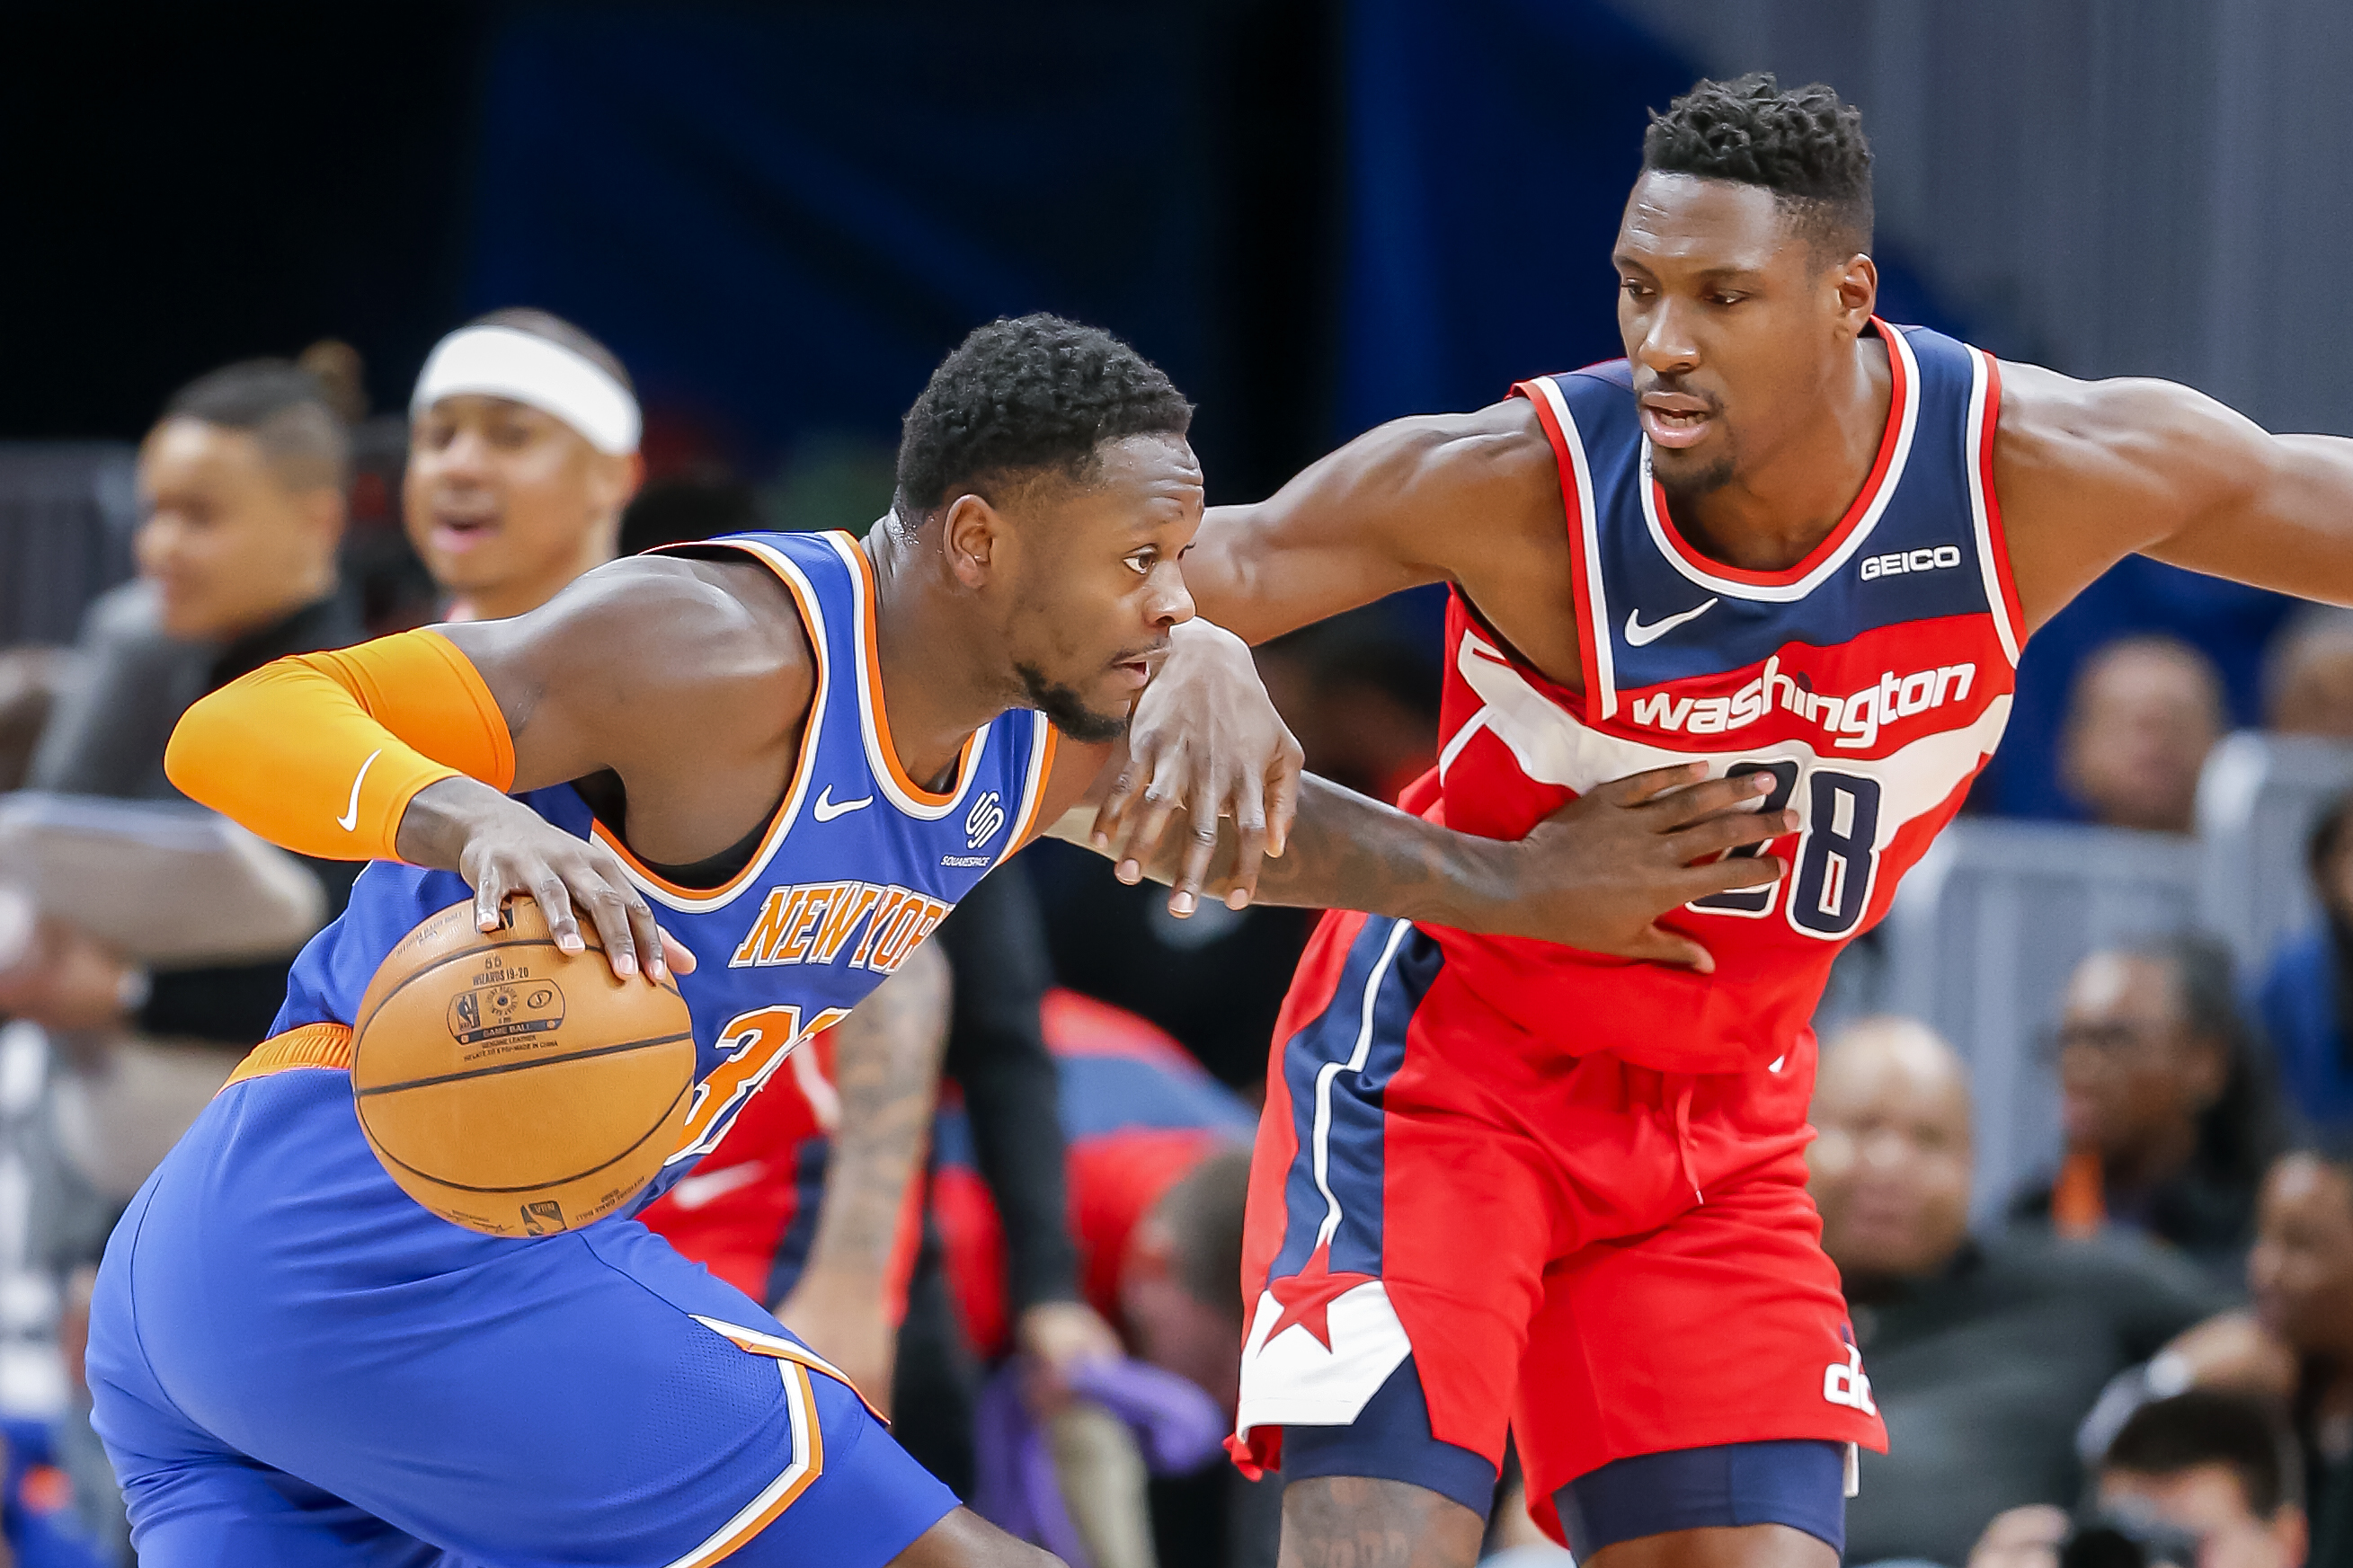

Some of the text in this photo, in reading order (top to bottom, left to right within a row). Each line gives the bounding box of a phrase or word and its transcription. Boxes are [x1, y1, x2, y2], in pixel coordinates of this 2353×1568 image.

[1860, 545, 1960, 581] GEICO
[1632, 655, 1976, 749] washington
[940, 855, 990, 867] SQUARESPACE
[728, 880, 955, 974] NEW YOR
[473, 967, 529, 987] WIZARDS 19-20
[663, 1005, 853, 1166] 3
